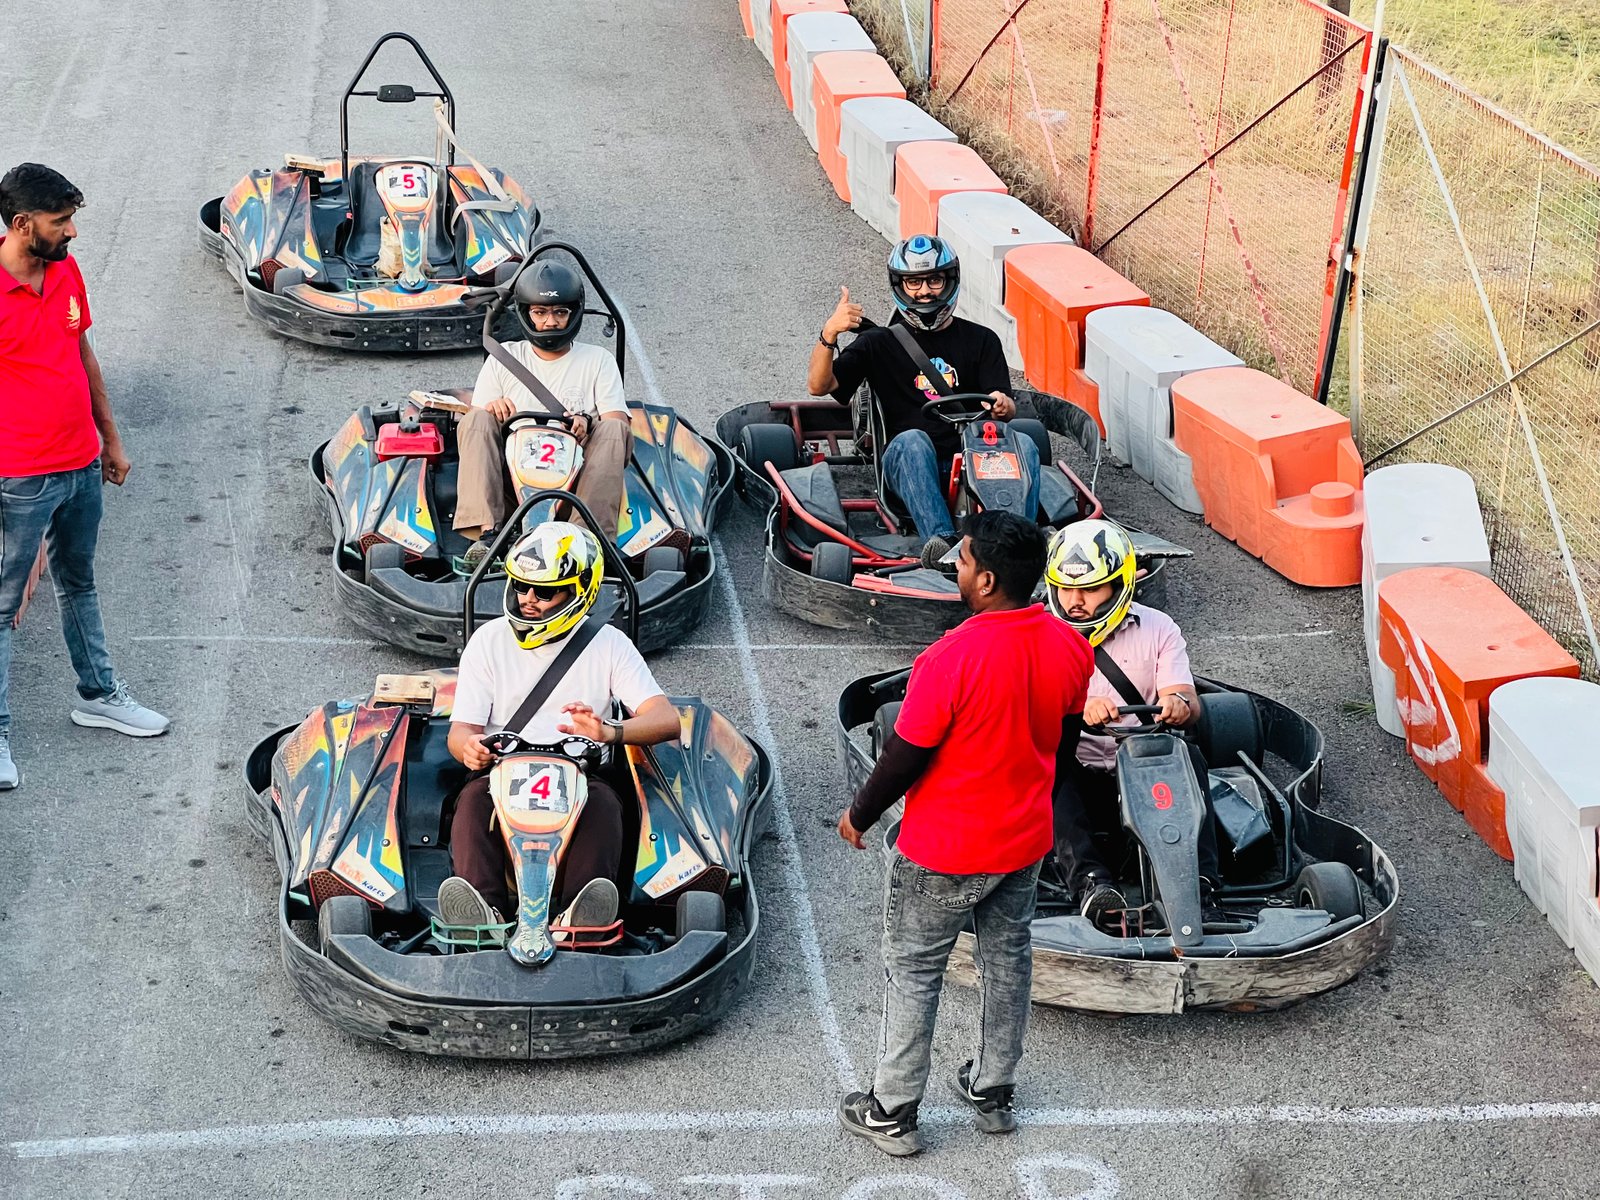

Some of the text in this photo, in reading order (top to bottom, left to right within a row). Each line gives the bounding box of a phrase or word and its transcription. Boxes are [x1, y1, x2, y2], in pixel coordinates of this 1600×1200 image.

[403, 174, 415, 189] 5
[982, 421, 998, 446] 8
[540, 443, 556, 464] 2
[530, 775, 551, 799] 4
[1151, 781, 1173, 810] 9
[678, 863, 701, 881] karts
[362, 880, 386, 898] karts
